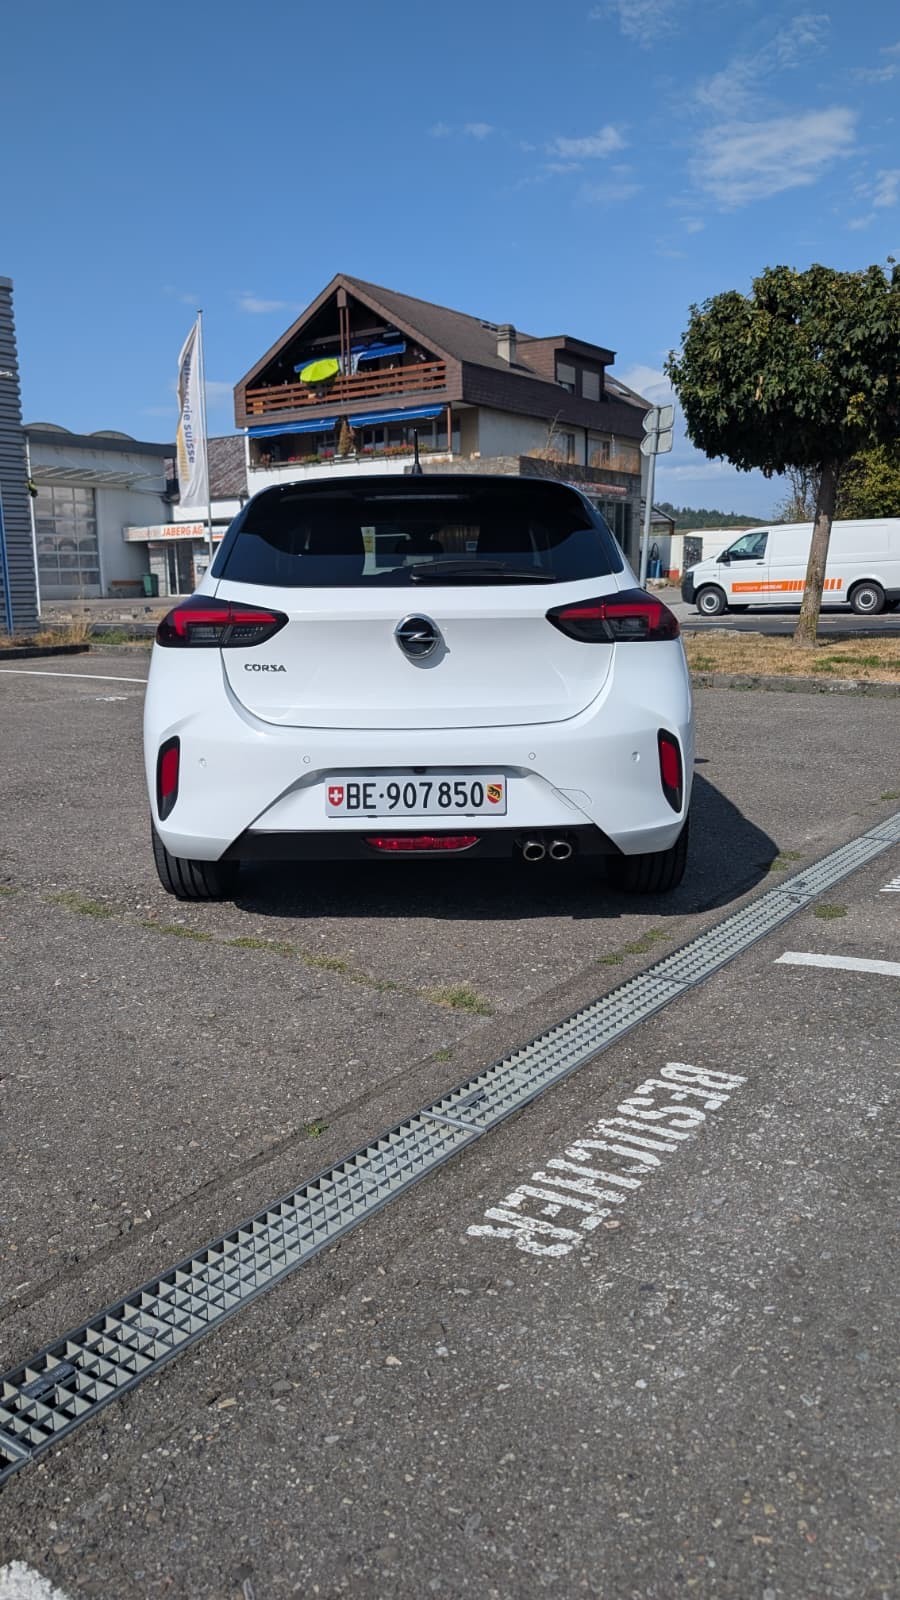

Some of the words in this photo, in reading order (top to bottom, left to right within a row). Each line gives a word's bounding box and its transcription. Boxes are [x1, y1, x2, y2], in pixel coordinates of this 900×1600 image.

[183, 424, 195, 464] suisse
[162, 526, 191, 537] JABERG
[192, 524, 204, 535] AG
[244, 663, 287, 672] CORSA
[466, 1062, 748, 1256] BESUCHER
